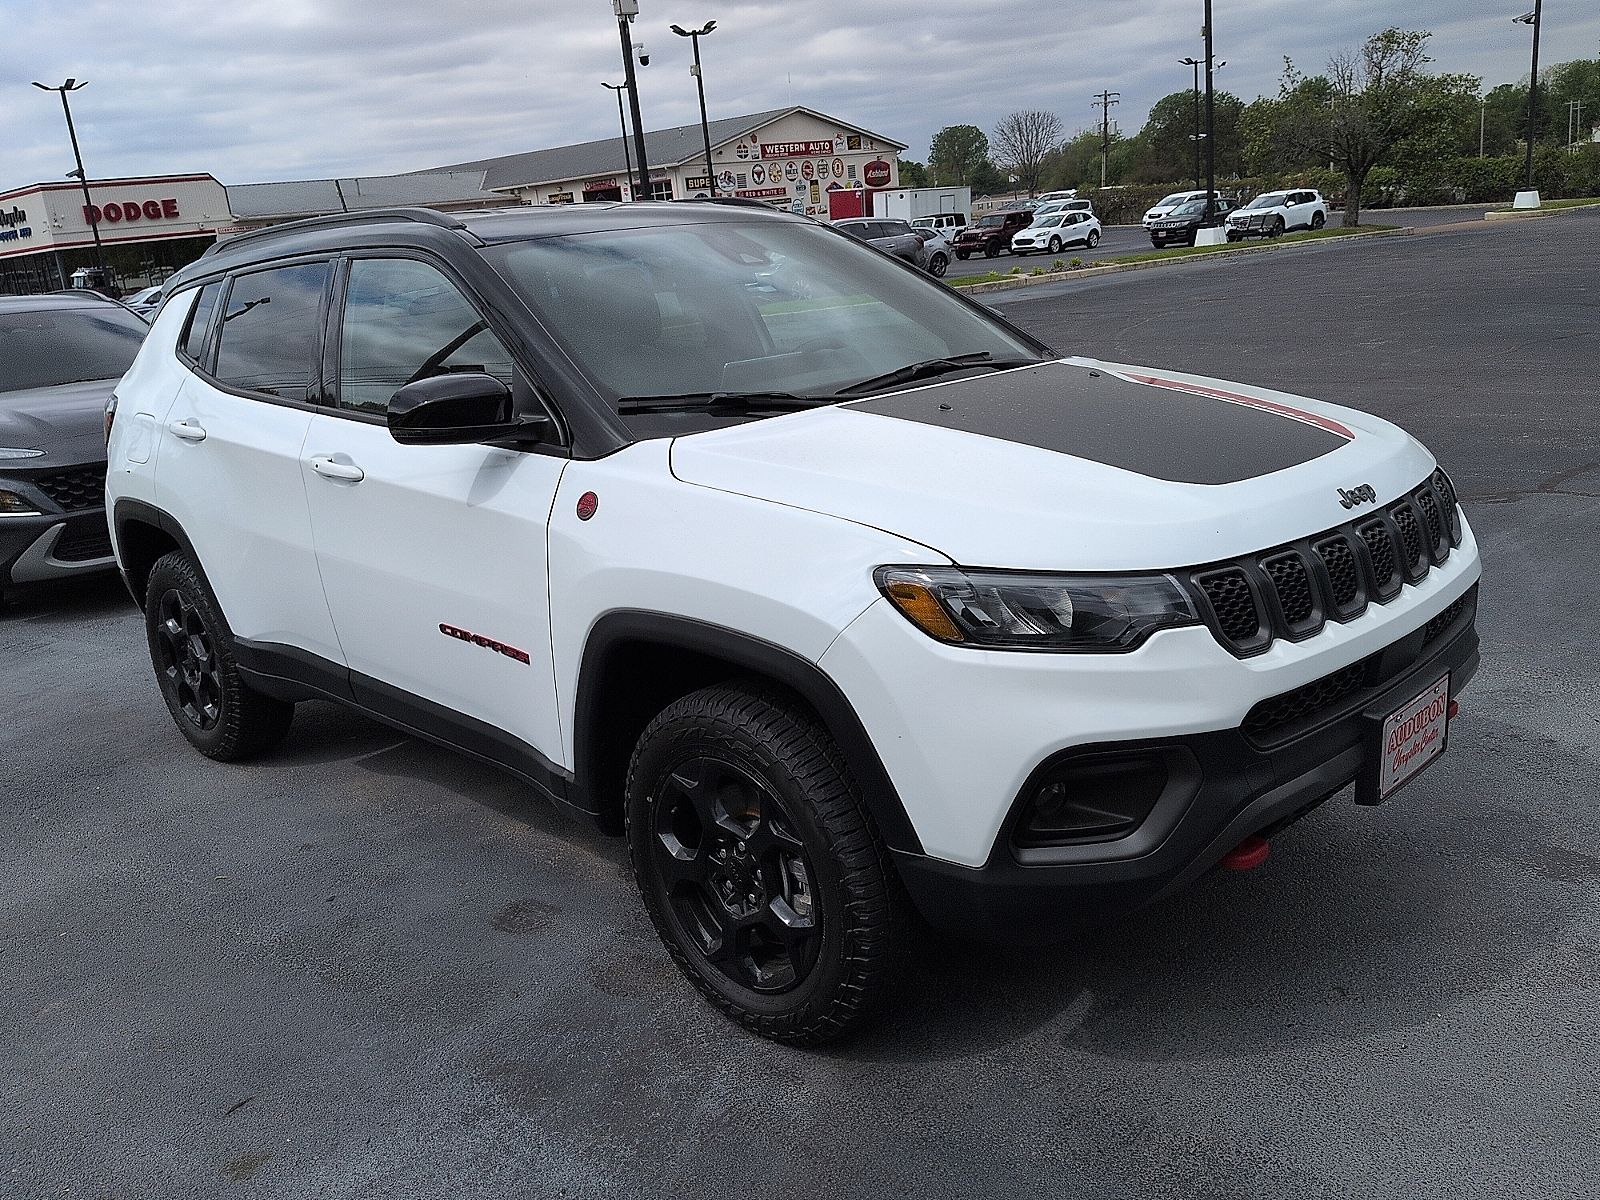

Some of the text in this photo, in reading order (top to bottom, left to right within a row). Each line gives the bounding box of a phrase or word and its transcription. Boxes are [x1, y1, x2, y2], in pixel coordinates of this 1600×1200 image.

[765, 143, 805, 154] WESTERN
[808, 141, 830, 151] AUTO
[688, 177, 717, 188] SUPE
[82, 198, 180, 225] DODGE
[1336, 483, 1377, 510] Jeep
[1387, 691, 1446, 755] AUDUBON
